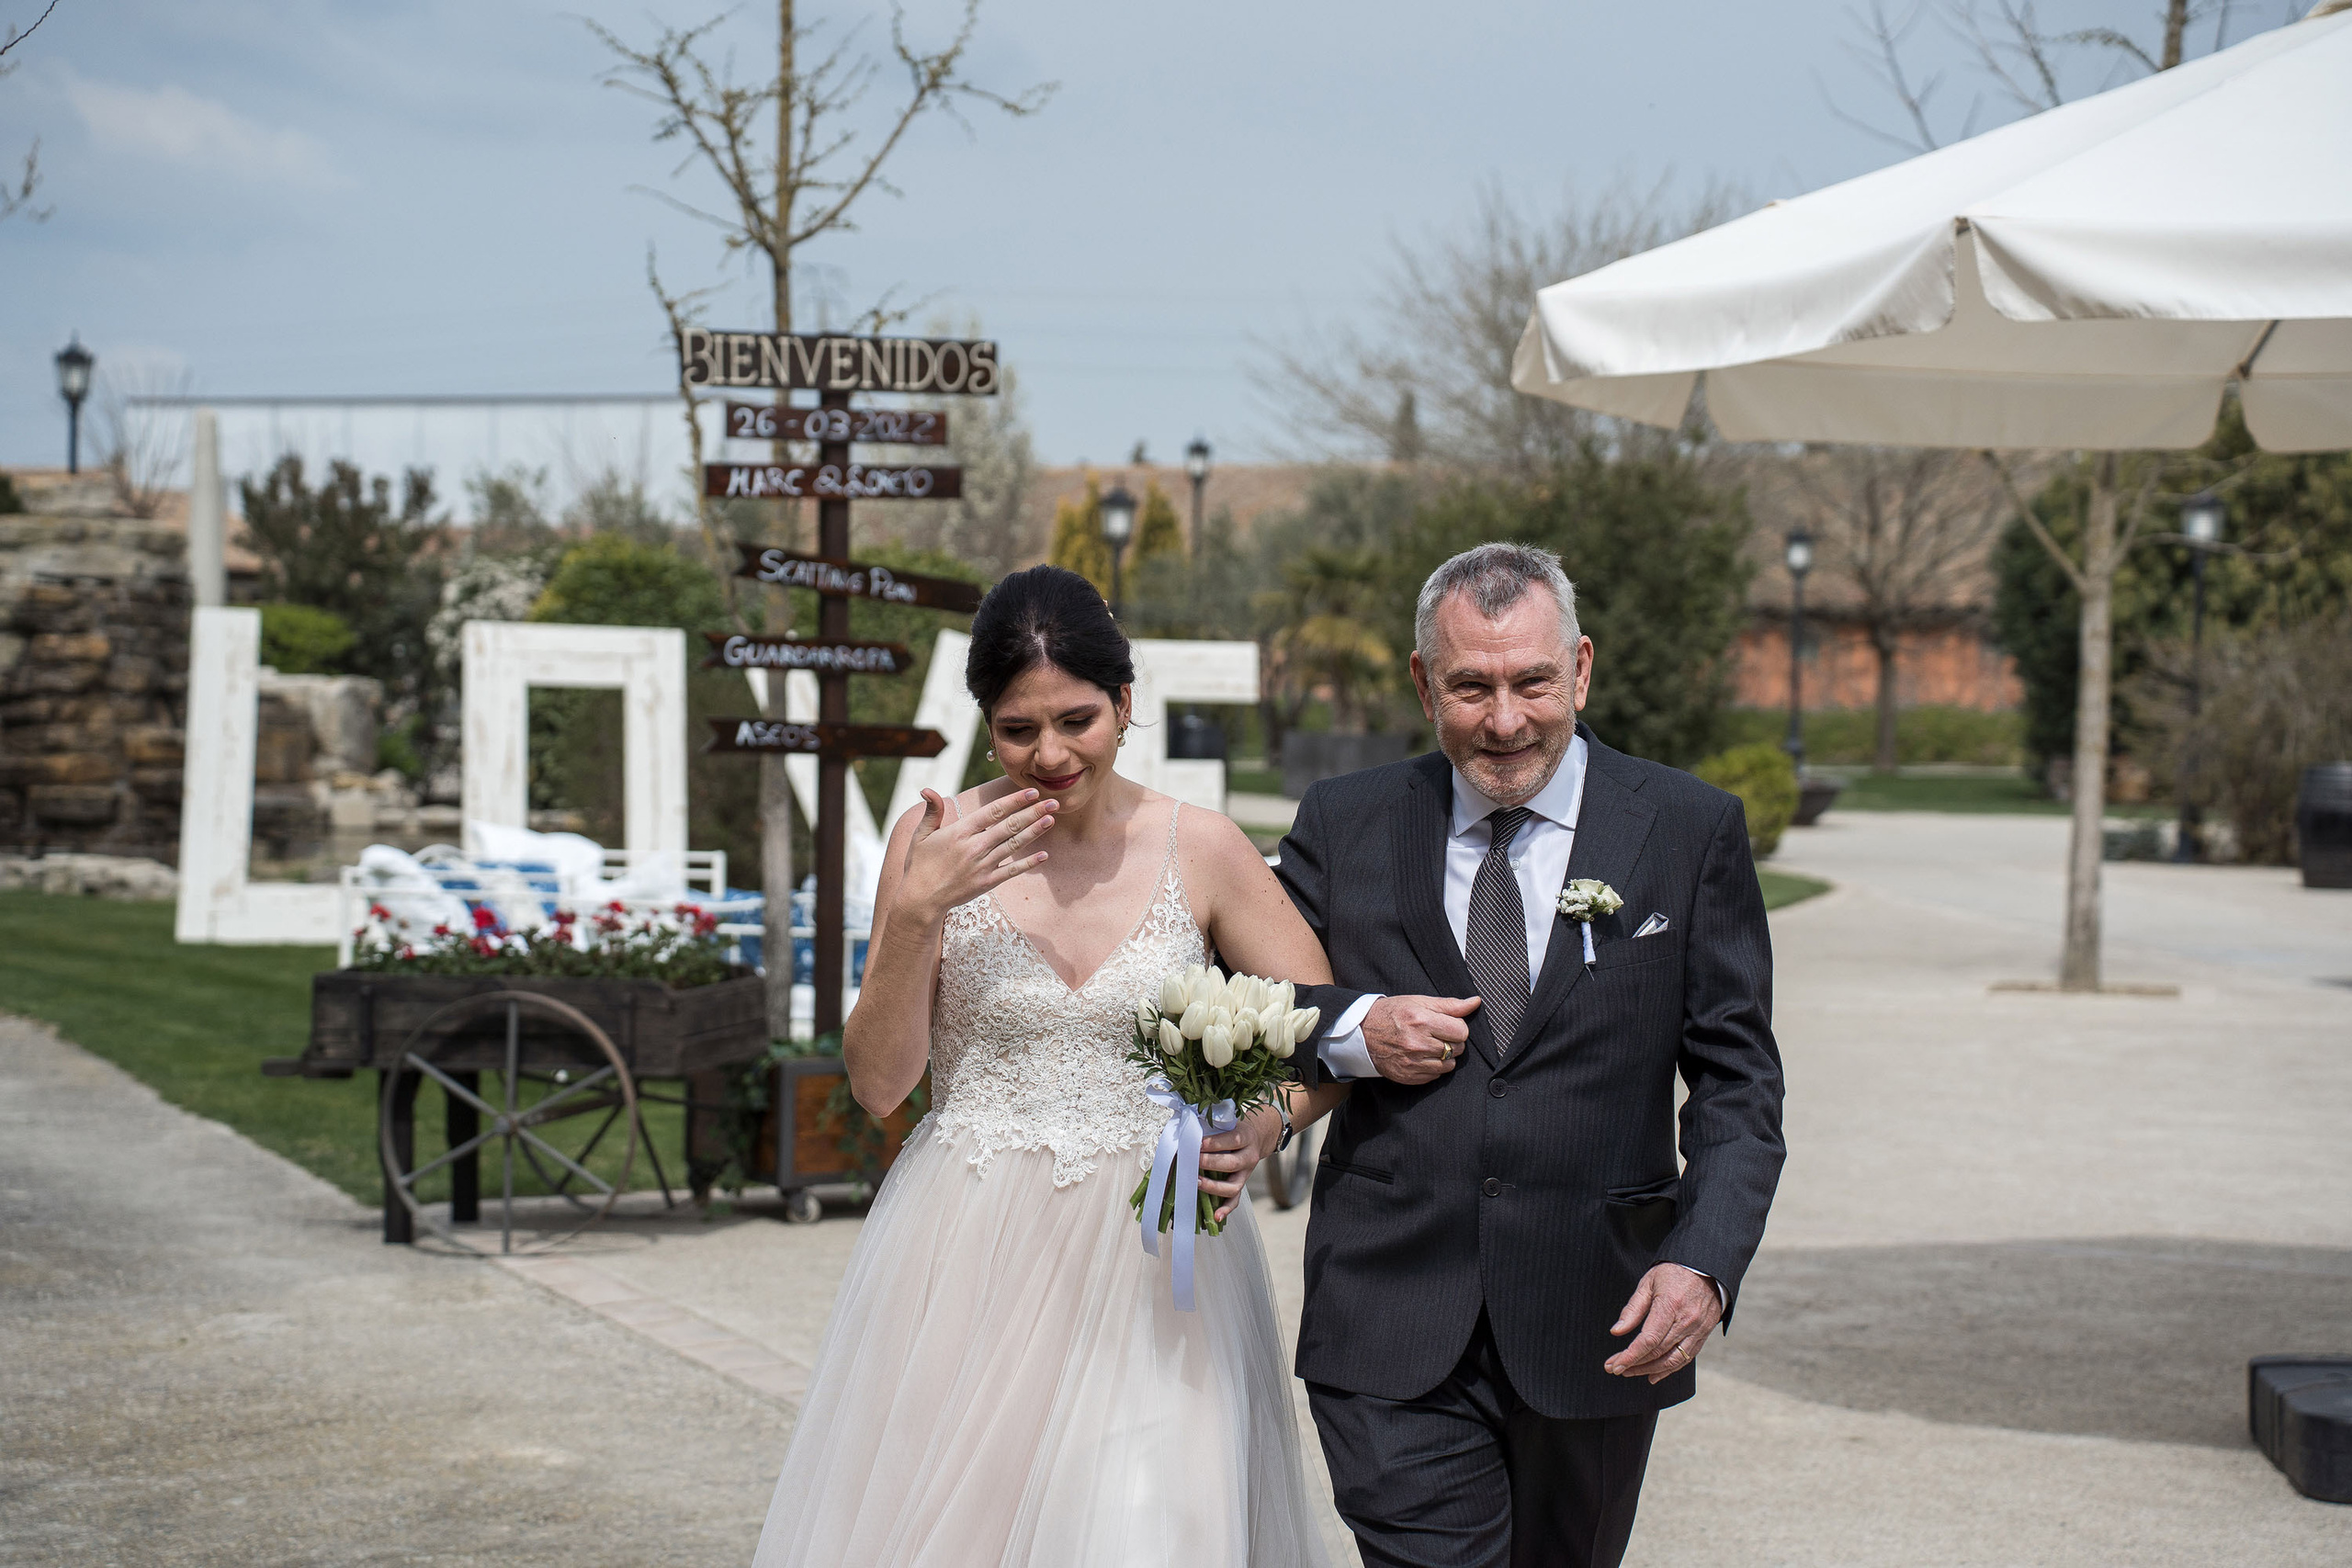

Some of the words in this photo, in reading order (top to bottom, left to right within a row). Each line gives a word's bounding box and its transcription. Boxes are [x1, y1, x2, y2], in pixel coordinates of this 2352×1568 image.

[682, 327, 999, 395] BIENVENIDOS
[726, 467, 806, 498] MARC
[736, 720, 821, 750] ASEOS
